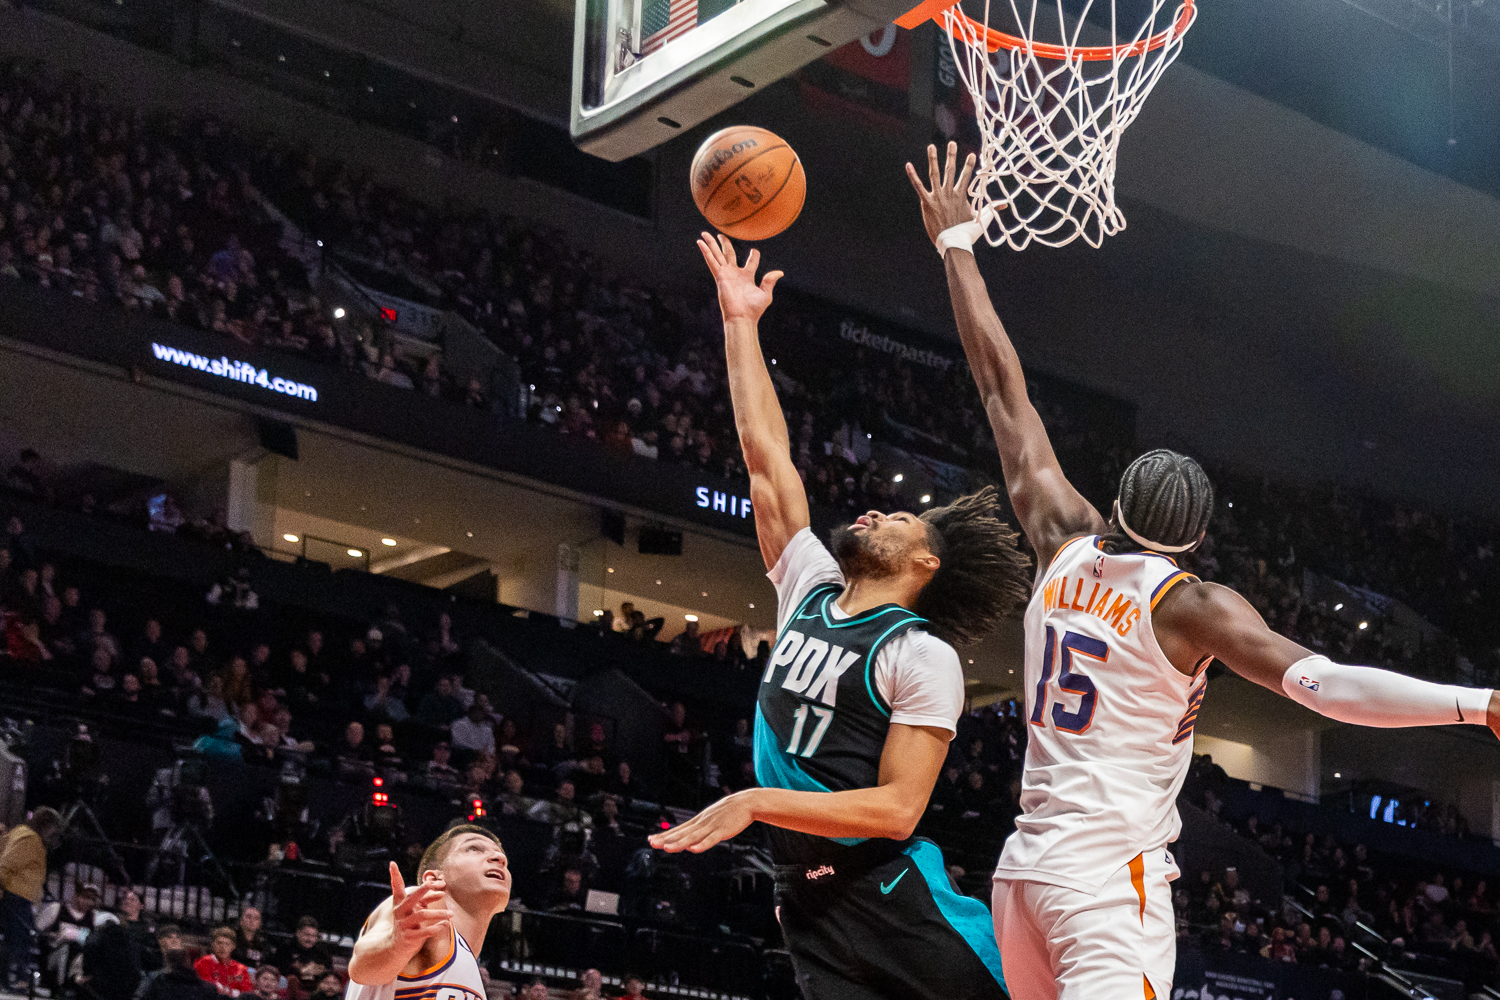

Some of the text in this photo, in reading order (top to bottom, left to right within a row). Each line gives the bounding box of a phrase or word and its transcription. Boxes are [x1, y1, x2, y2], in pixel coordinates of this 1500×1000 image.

[152, 342, 317, 402] www.shift4.com
[695, 486, 752, 519] SHIF
[1044, 576, 1141, 637] WILLIAMS
[763, 630, 861, 707] PDX
[1031, 625, 1109, 735] 15
[786, 704, 834, 758] 17
[805, 864, 835, 880] ripcity
